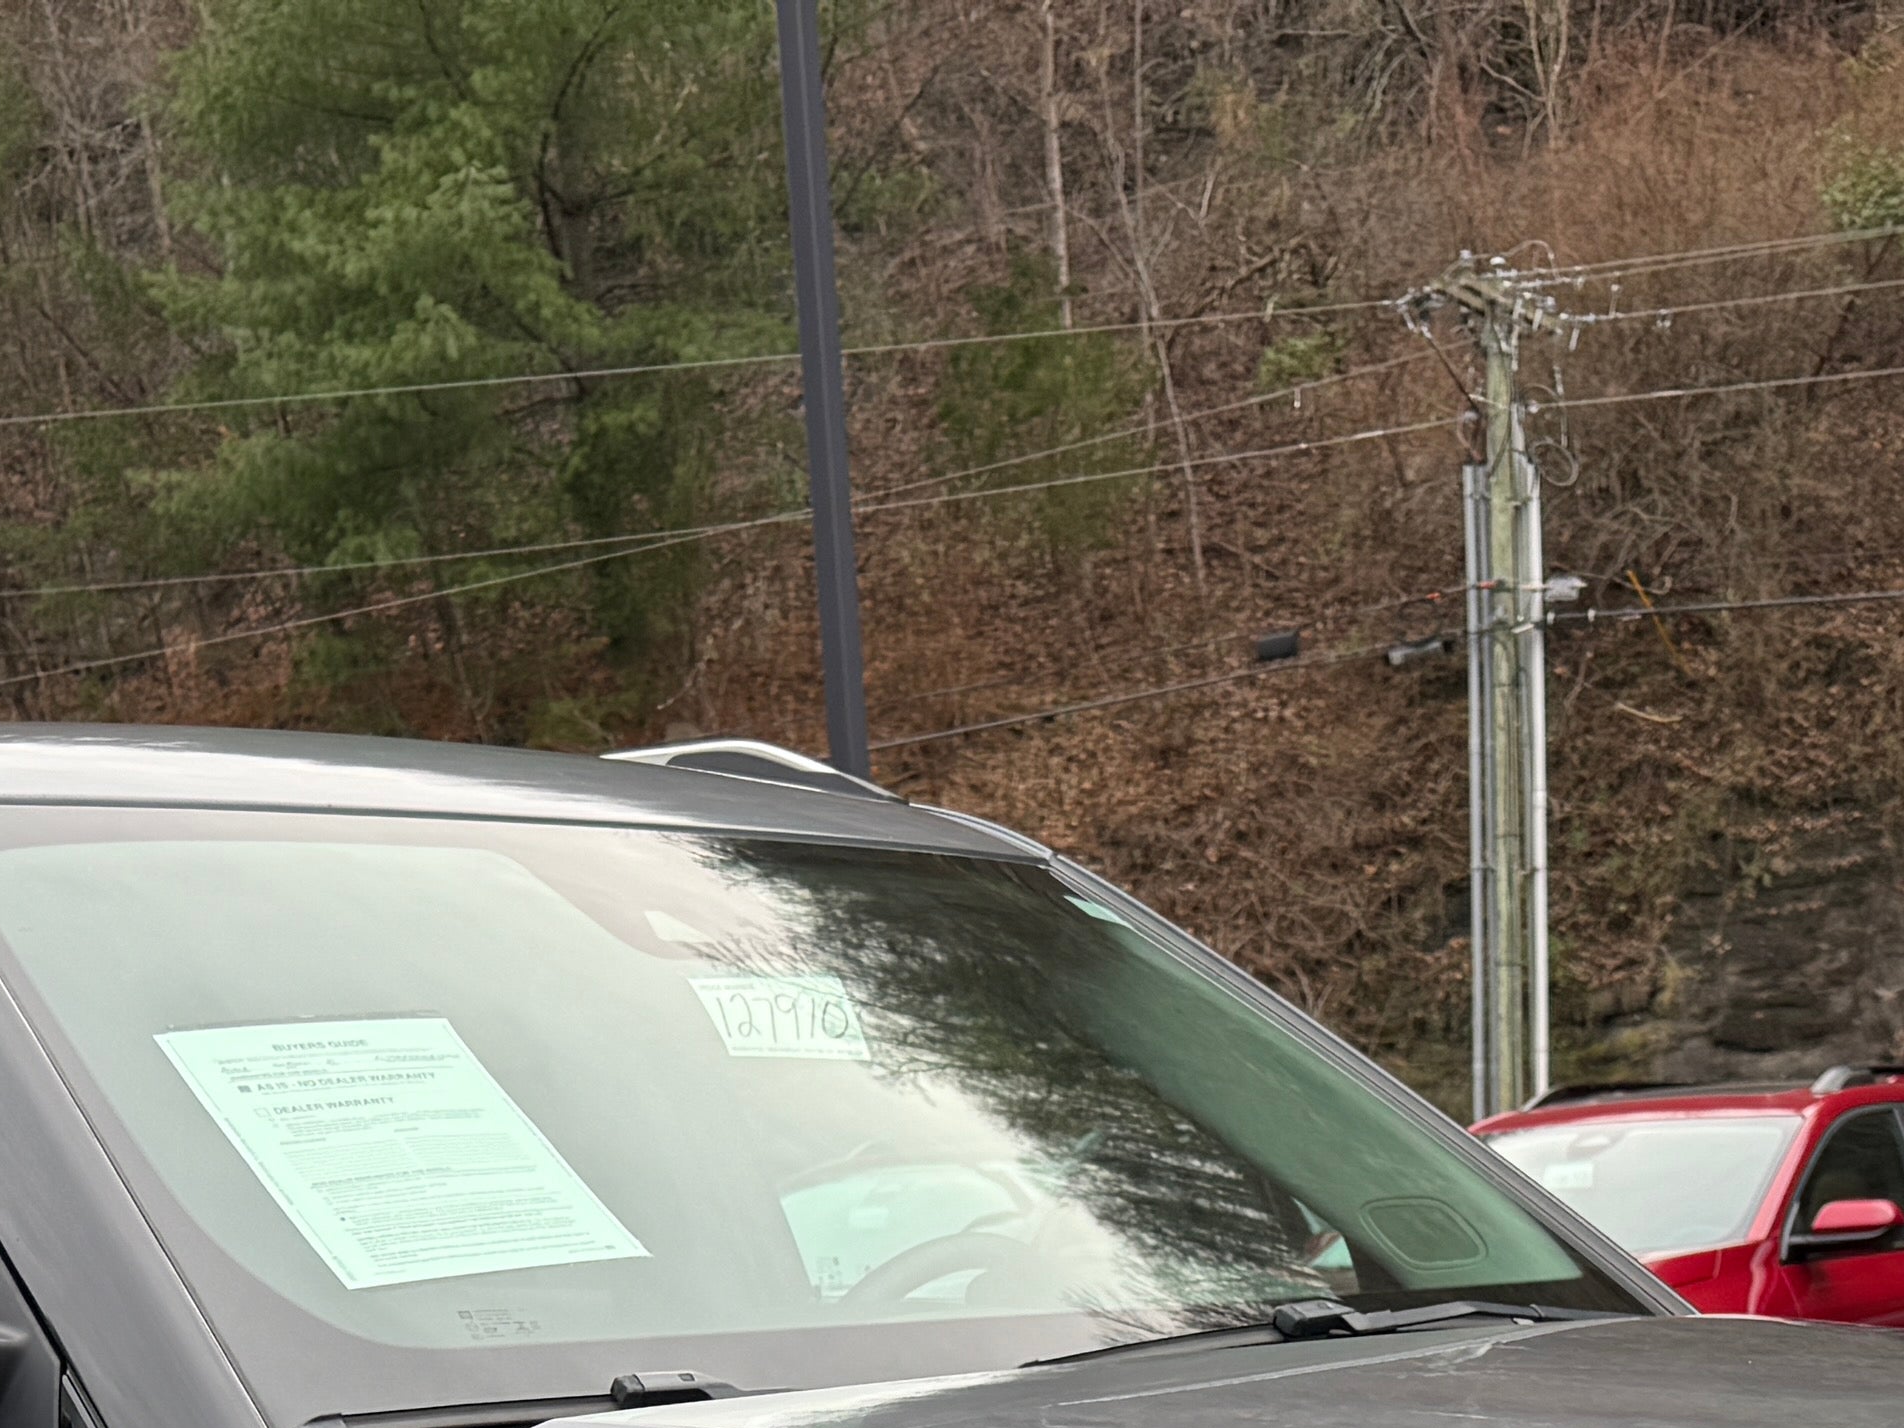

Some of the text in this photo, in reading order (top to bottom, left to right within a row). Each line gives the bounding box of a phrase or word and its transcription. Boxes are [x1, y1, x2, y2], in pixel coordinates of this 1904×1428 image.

[716, 992, 849, 1043] 127910
[271, 1038, 369, 1052] BUYERS GUIDE
[319, 1075, 367, 1087] DEALER
[369, 1071, 436, 1083] WARRANTY
[272, 1096, 394, 1115] DEALER WARRANTY
